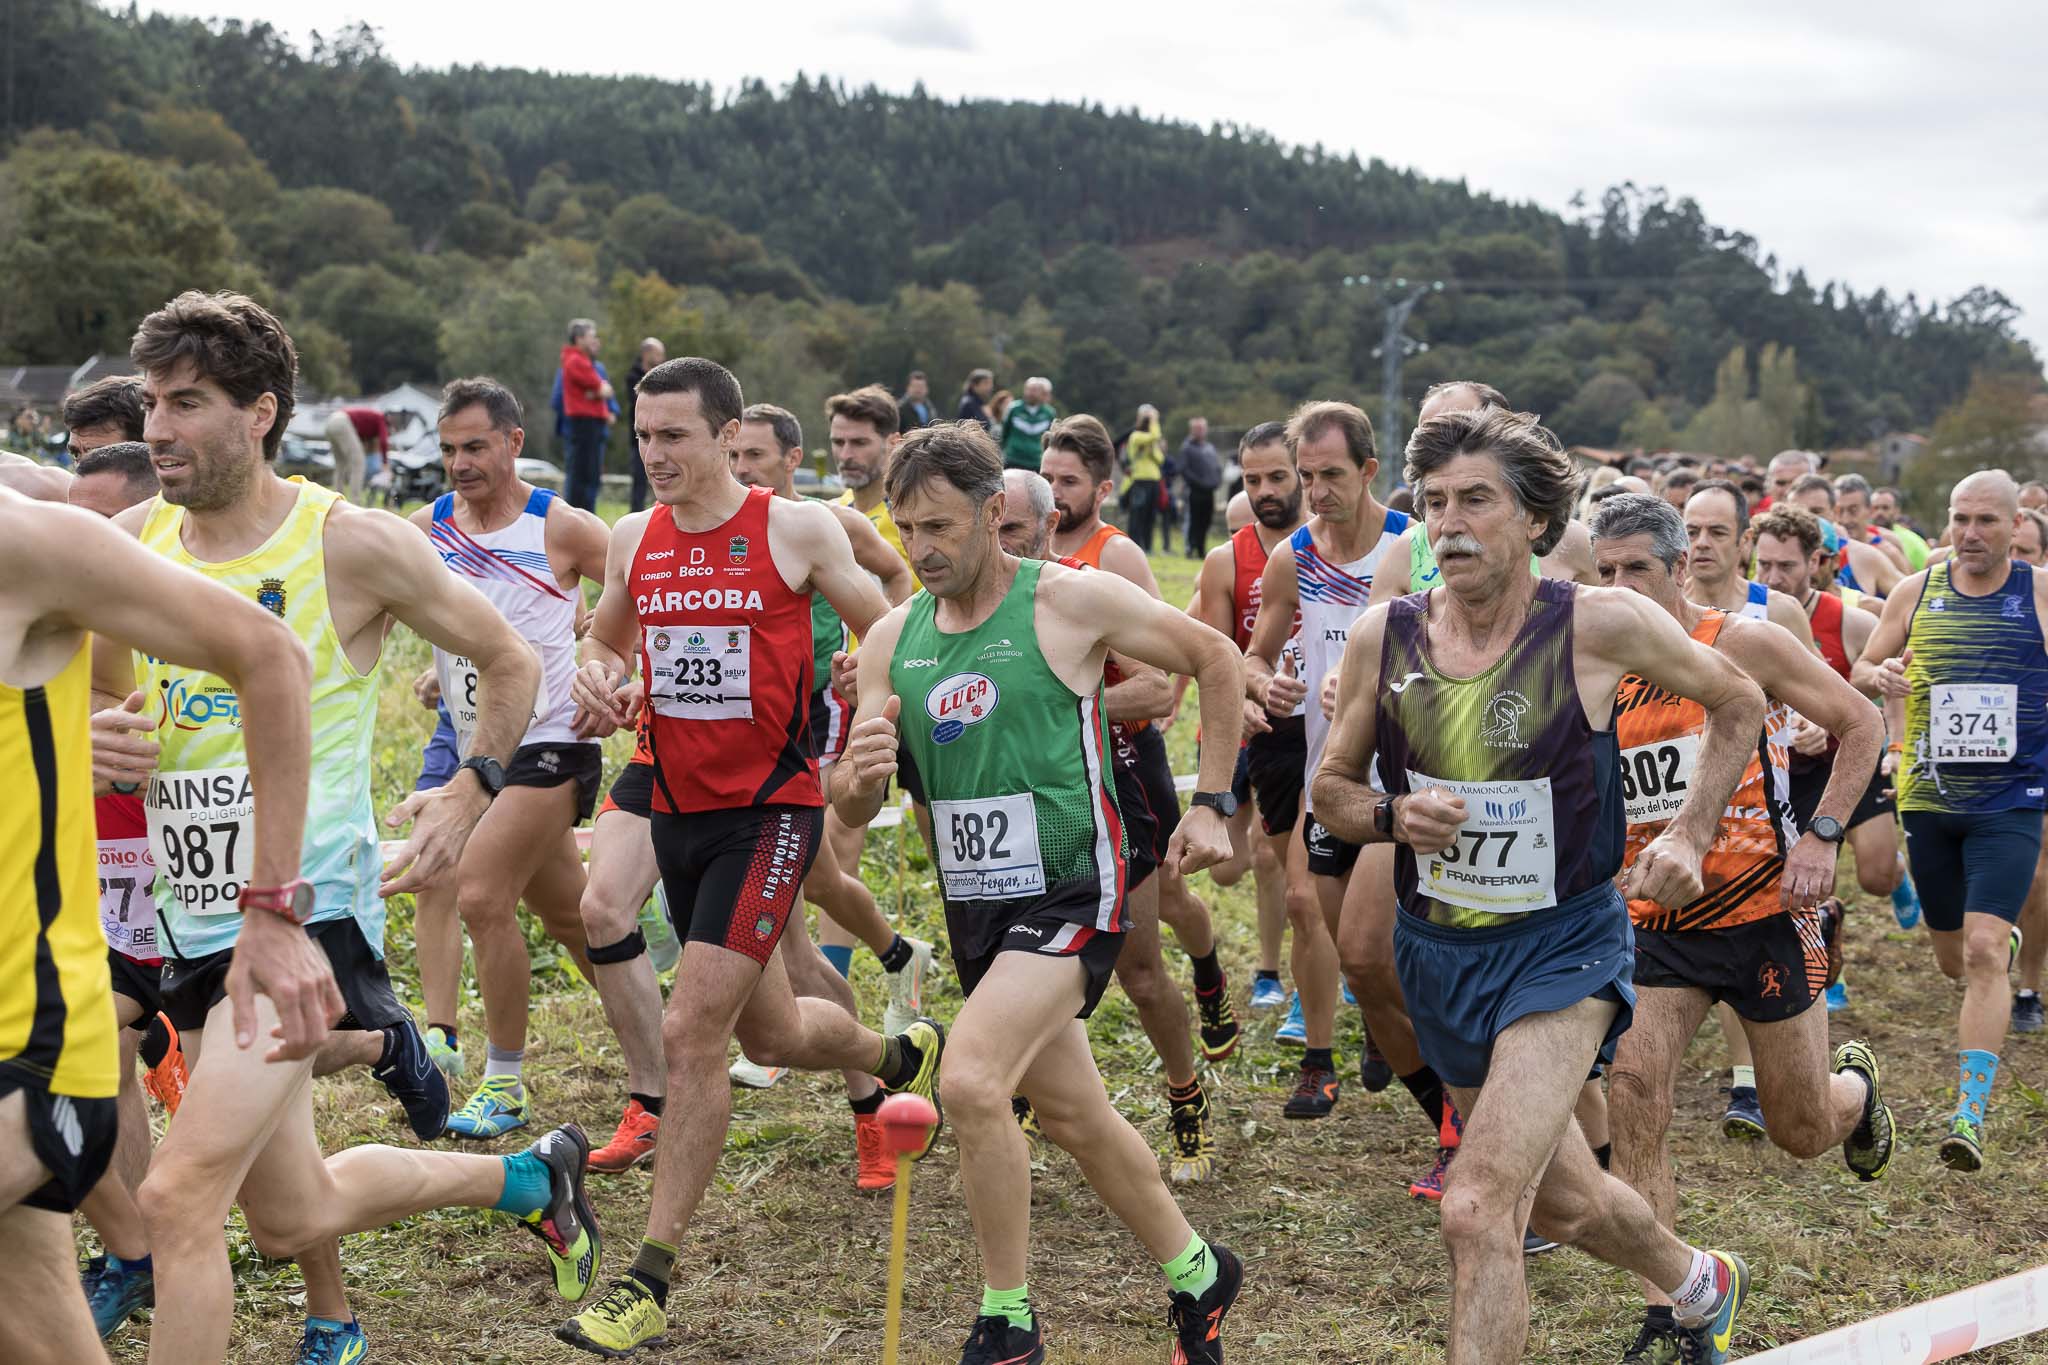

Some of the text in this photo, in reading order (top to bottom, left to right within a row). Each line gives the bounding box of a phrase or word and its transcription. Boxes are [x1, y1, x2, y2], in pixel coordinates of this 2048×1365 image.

[640, 571, 673, 581] LOREDO
[679, 566, 714, 577] Beco
[636, 588, 764, 615] CÁRCOBA
[674, 657, 722, 686] 233
[939, 680, 987, 716] LUCA
[1948, 713, 1998, 736] 374
[1484, 741, 1529, 749] ATLETISMO
[1937, 746, 2008, 757] La Encina
[1647, 800, 1661, 813] del
[951, 809, 1011, 862] 582
[162, 821, 240, 880] 987
[781, 833, 800, 885] AL MAR
[1446, 869, 1538, 887] FRANFERMA
